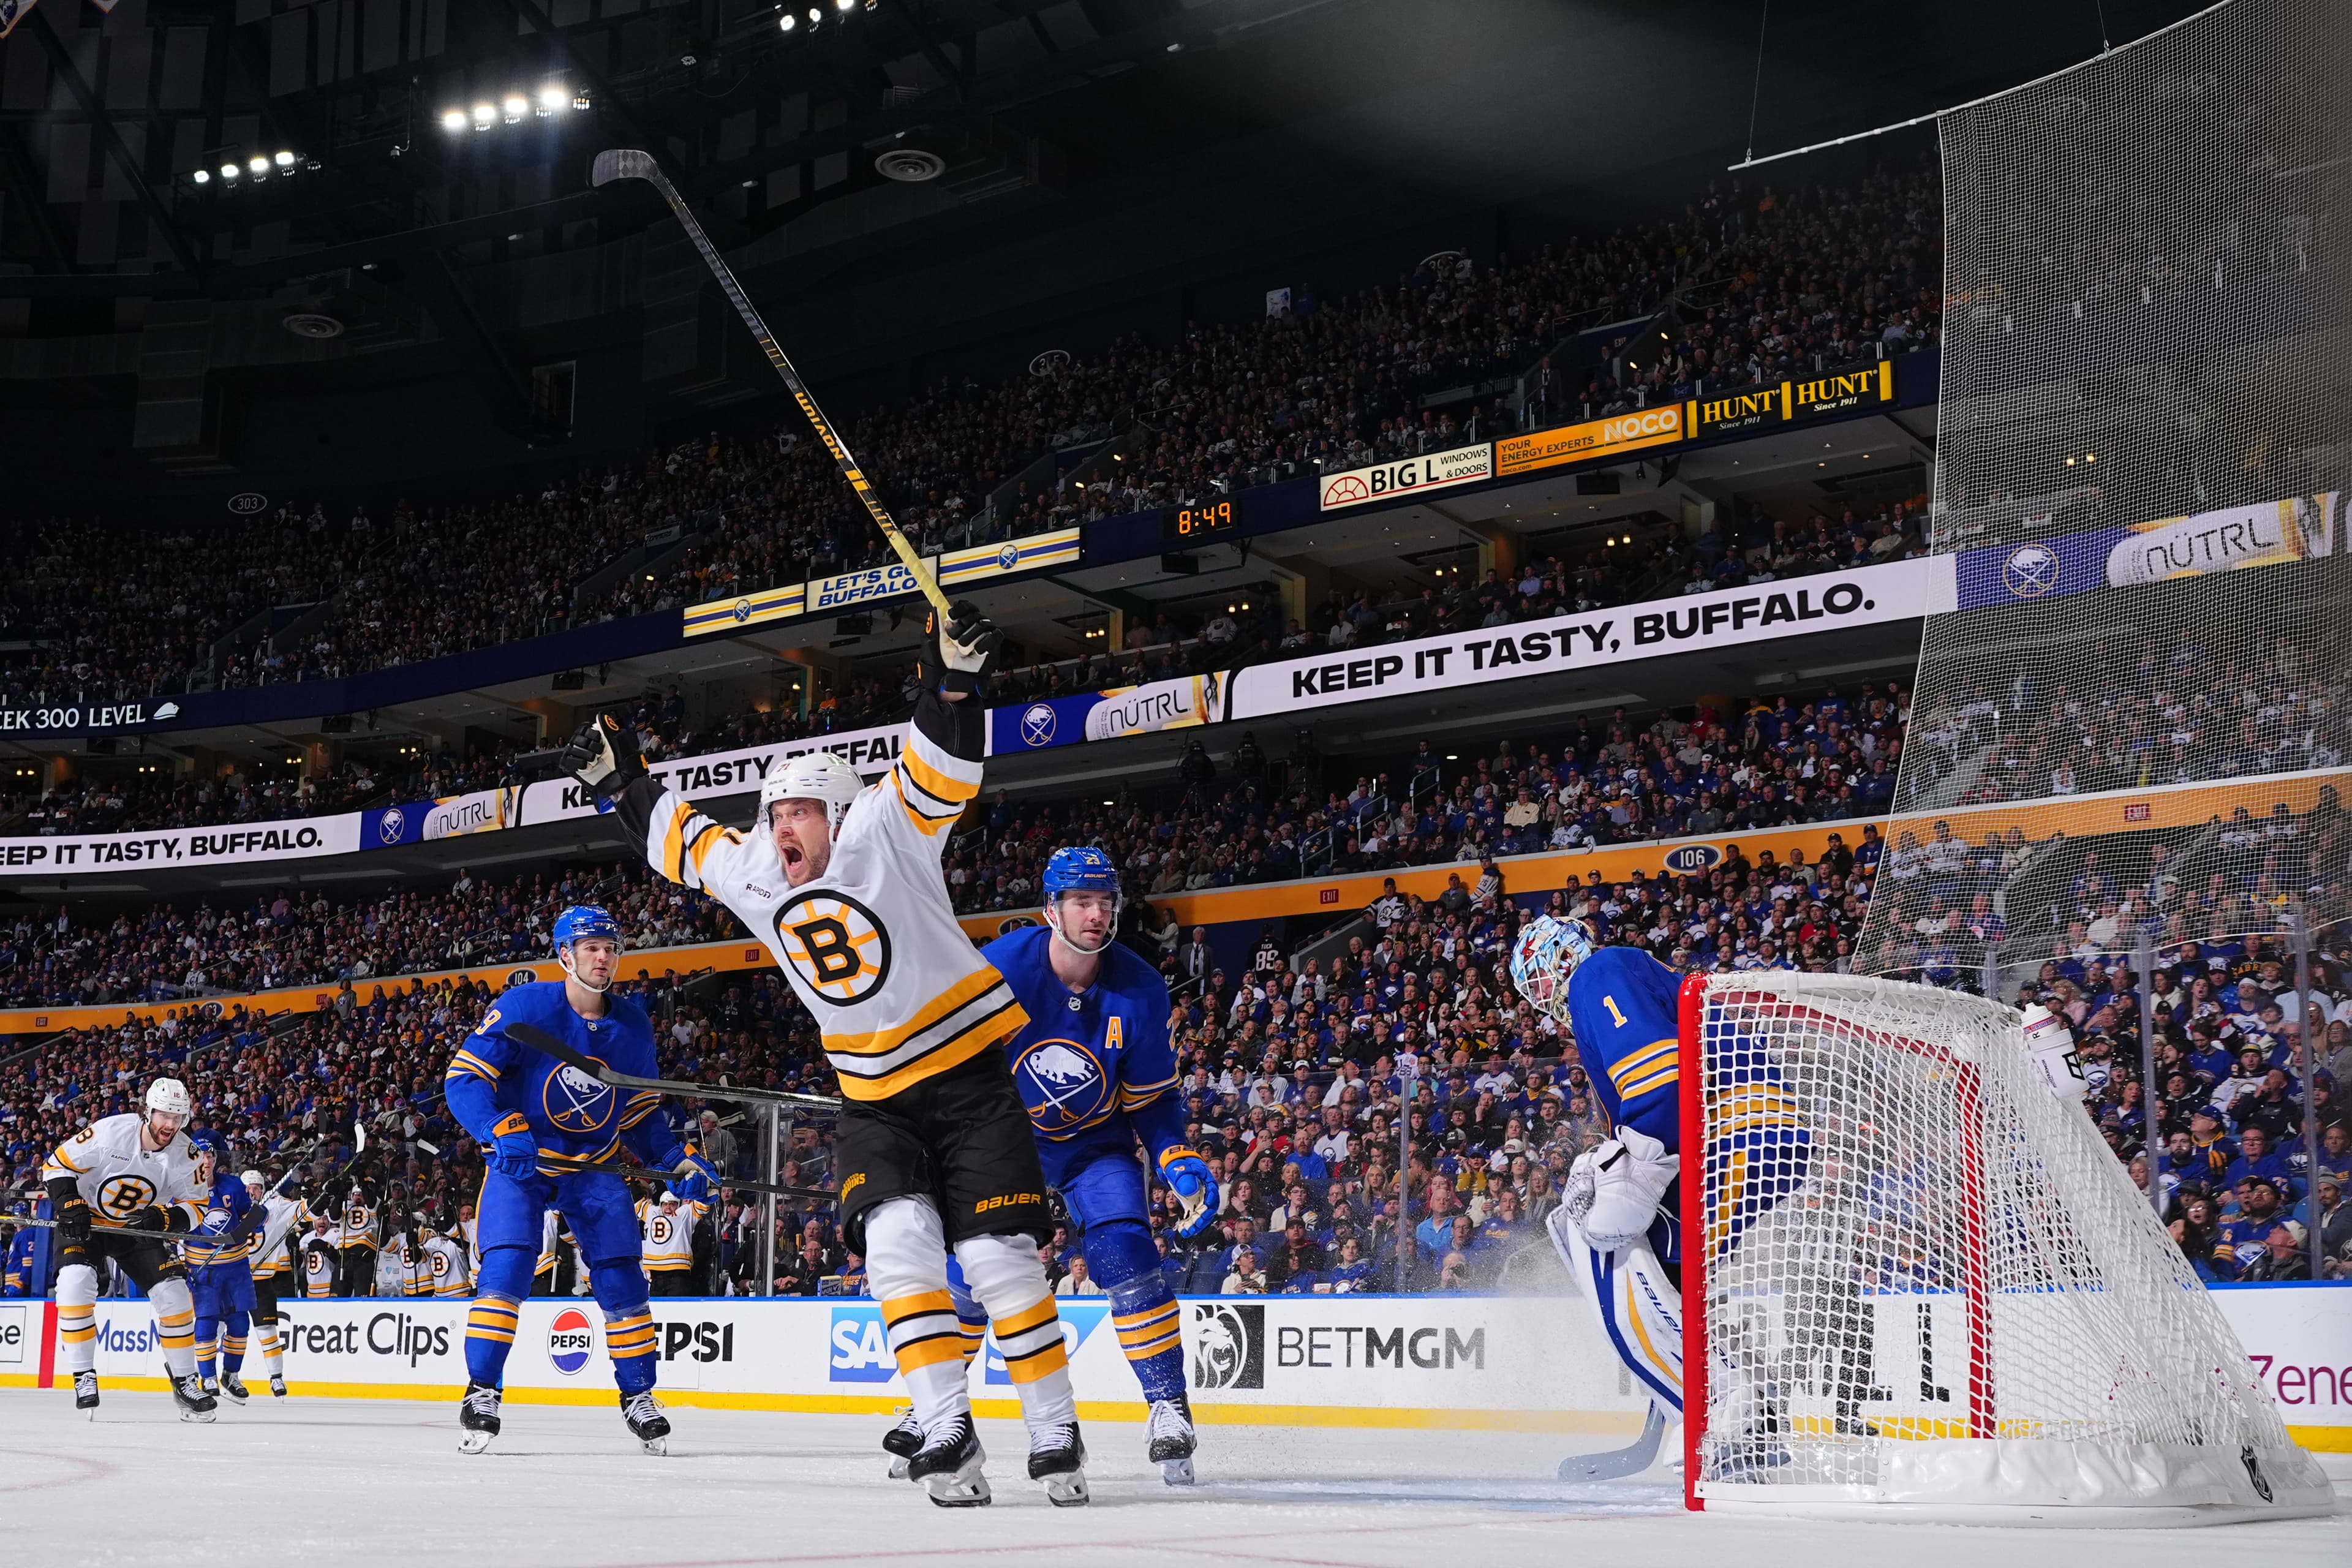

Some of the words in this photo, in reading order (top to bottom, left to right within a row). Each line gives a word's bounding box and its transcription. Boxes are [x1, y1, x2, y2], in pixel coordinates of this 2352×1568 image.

[1796, 370, 1872, 405] HUNT
[1702, 390, 1776, 424] HUNT
[1814, 401, 1836, 412] Since
[1839, 397, 1858, 408] 1911
[795, 392, 845, 459] NOVIUM
[1604, 410, 1678, 441] NOCO
[1719, 421, 1740, 430] Since
[1744, 416, 1760, 426] 1911
[1501, 440, 1531, 452] YOUR
[1501, 447, 1544, 462] ENERGY
[1547, 436, 1594, 453] EXPERTS
[1441, 448, 1488, 465] WINDOWS
[1371, 463, 1417, 494] BIG
[1426, 459, 1439, 483] L
[1446, 470, 1453, 478] &
[1455, 462, 1488, 477] DOORS
[1501, 464, 1531, 474] noco.com
[238, 497, 258, 510] 303
[1179, 502, 1231, 534] 8:49
[823, 570, 882, 593] LET'S
[1293, 654, 1403, 698] KEEP
[1415, 646, 1452, 679] IT
[1464, 620, 1621, 670] TASTY,
[1634, 582, 1875, 646] BUFFALO.
[0, 710, 31, 730] EK
[36, 708, 80, 729] 300
[88, 704, 146, 727] LEVEL
[777, 763, 791, 772] 71
[0, 845, 48, 865] EP
[55, 845, 81, 864] IT
[89, 838, 183, 863] TASTY,
[190, 827, 323, 856] BUFFALO.
[1086, 856, 1101, 865] 23
[1680, 848, 1705, 866] 106
[1322, 890, 1336, 902] EXIT
[747, 950, 757, 960] EXIT
[792, 917, 861, 984] B
[1256, 949, 1279, 971] 89
[514, 972, 529, 984] 104
[1604, 995, 1628, 1028] 1
[37, 1018, 47, 1027] EXIT
[1104, 1016, 1123, 1049] A
[75, 1126, 94, 1145] 8
[193, 1166, 206, 1186] 18
[110, 1183, 143, 1211] B
[222, 1194, 232, 1208] C
[350, 1210, 363, 1224] B
[653, 1221, 668, 1238] B
[308, 1254, 318, 1270] B
[433, 1256, 444, 1272] B
[277, 1311, 358, 1354] Great
[368, 1312, 449, 1368] Clips
[551, 1335, 590, 1348] PEPSI
[831, 1320, 897, 1370] SA
[1278, 1327, 1485, 1370] BETMGM
